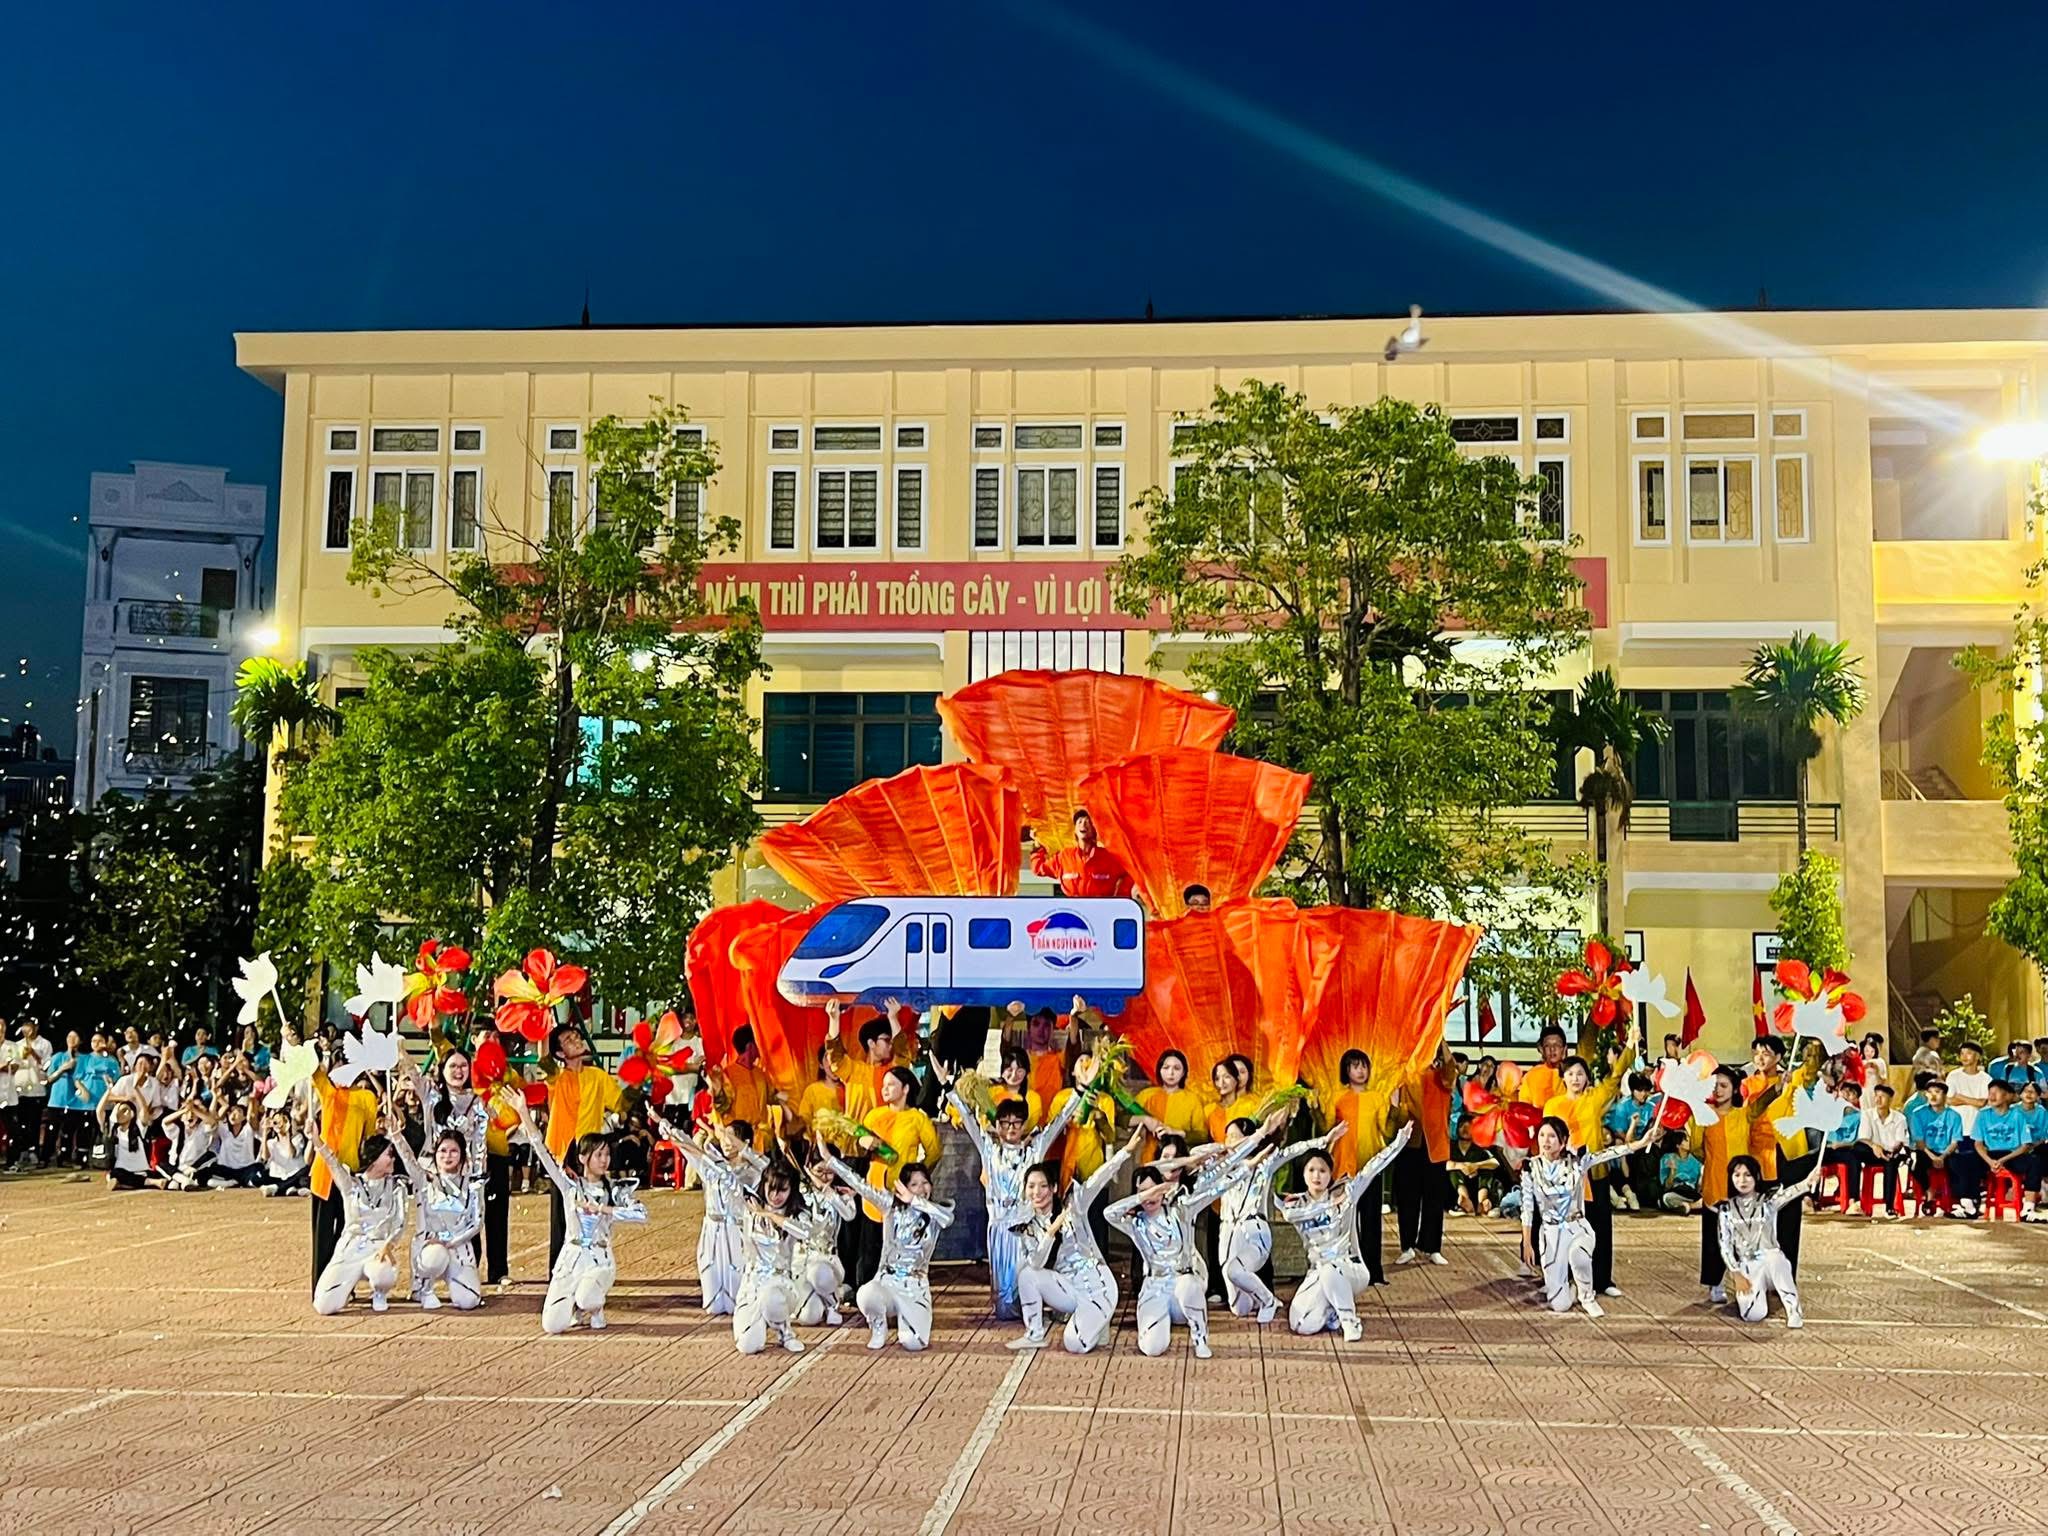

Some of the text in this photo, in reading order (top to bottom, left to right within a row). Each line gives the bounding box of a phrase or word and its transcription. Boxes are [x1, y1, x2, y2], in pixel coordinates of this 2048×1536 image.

[768, 574, 806, 616] THÌ
[812, 570, 869, 616] PHẢI
[876, 569, 956, 616] TRỒNG
[963, 573, 1011, 616] CÂY
[1034, 573, 1057, 616] VÌ
[1064, 576, 1102, 623] LỢI
